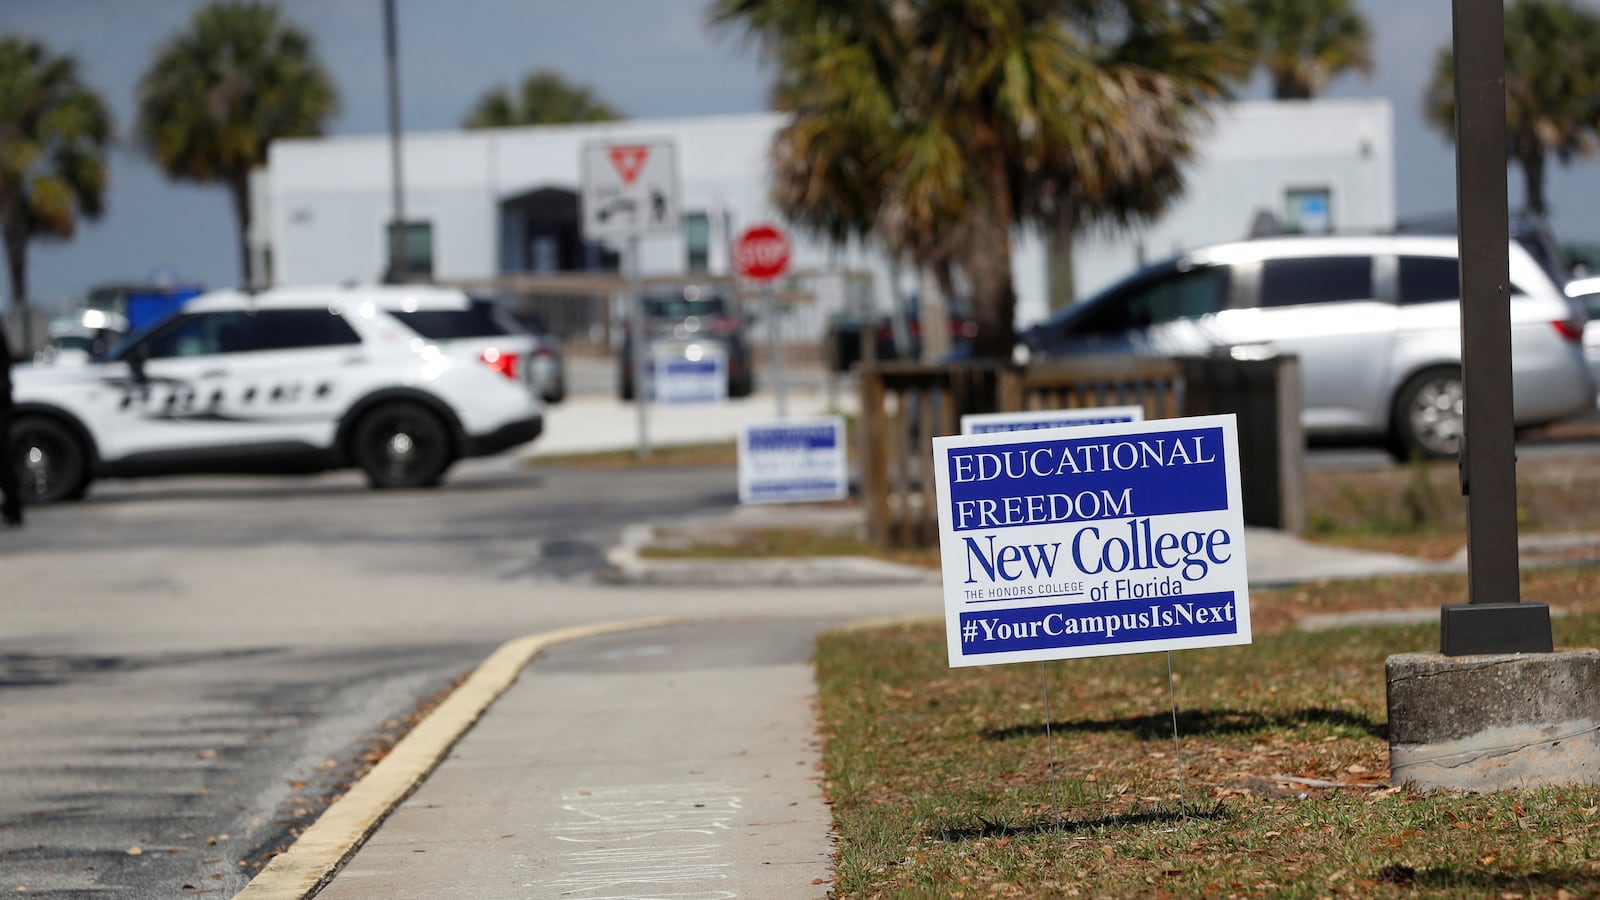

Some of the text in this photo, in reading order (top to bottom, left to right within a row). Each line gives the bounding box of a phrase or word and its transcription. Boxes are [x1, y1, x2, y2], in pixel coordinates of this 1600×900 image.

[736, 238, 790, 268] STOP
[952, 436, 1216, 483] EDUCATIONAL
[955, 487, 1135, 529] FREEDOM
[962, 518, 1232, 584] New College
[964, 581, 1084, 600] THE HONORS COLLEGE
[1090, 576, 1183, 602] of Florida
[963, 601, 1234, 643] #YourCampusIsNext
